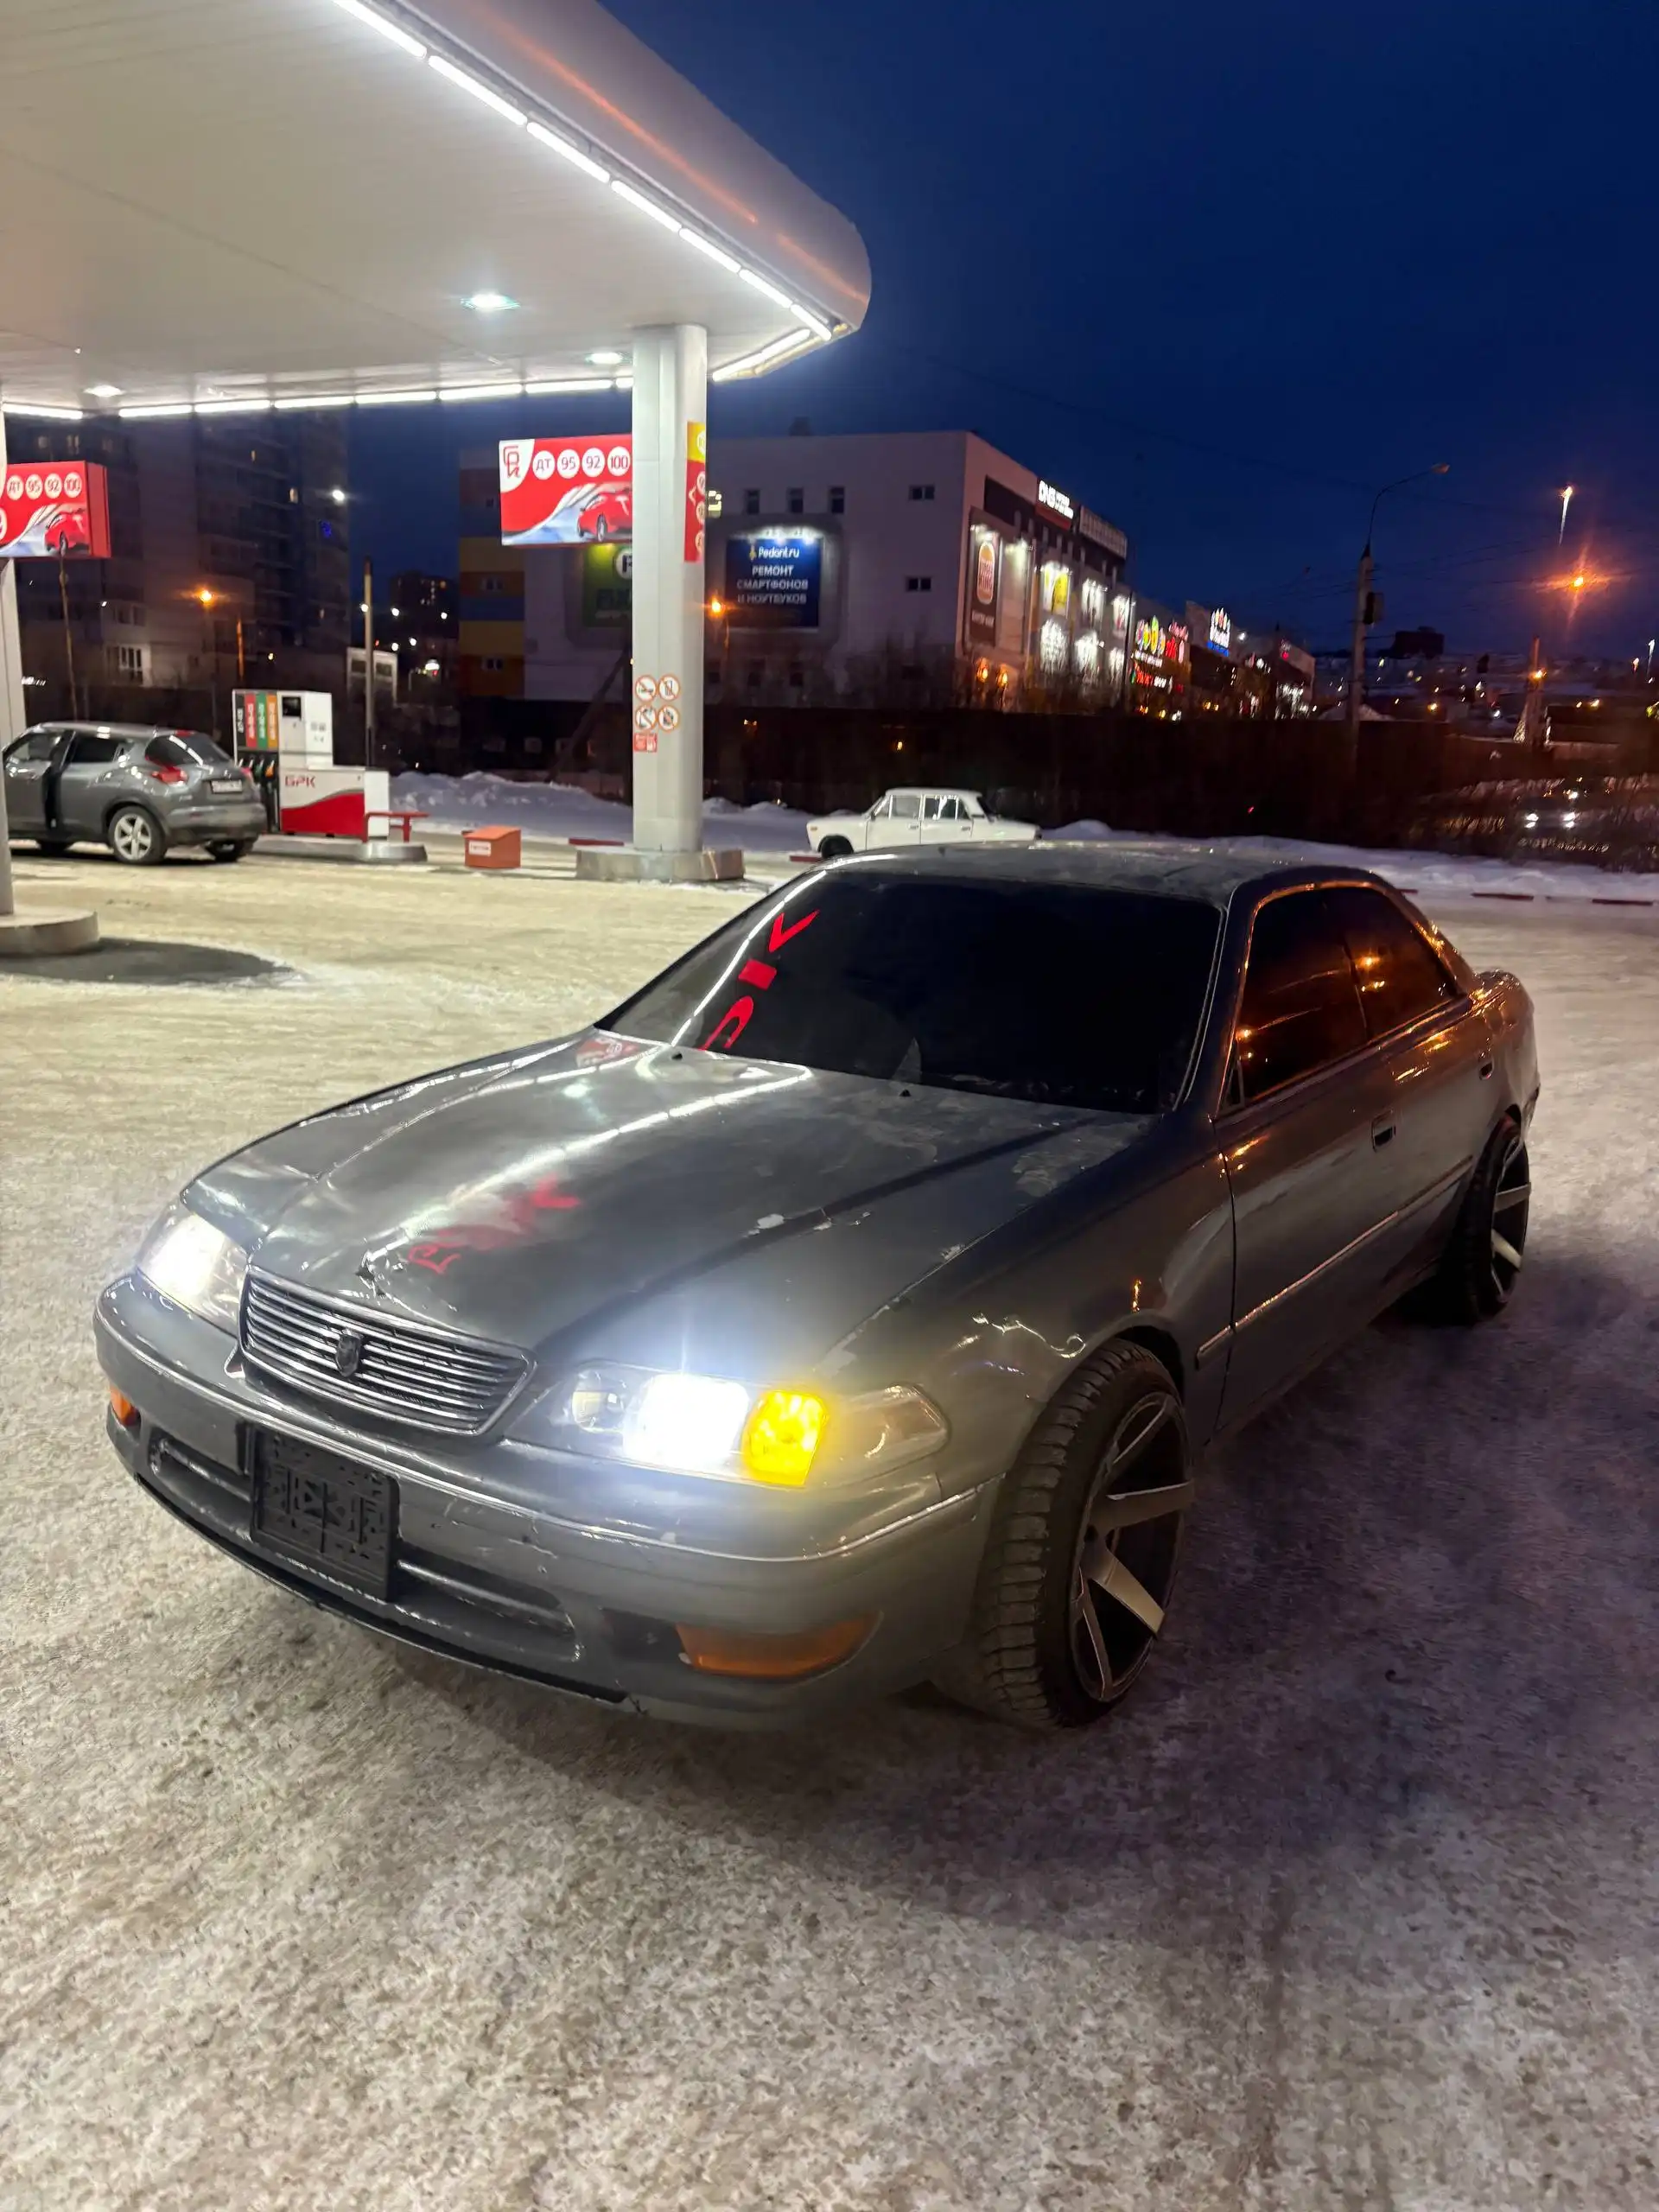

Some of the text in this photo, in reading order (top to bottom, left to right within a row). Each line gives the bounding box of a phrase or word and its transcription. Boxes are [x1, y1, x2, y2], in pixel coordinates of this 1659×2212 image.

[535, 454, 629, 472] ДТ 95 92 100
[752, 564, 795, 576] РЕМОНТ
[736, 579, 809, 590] СМАРТФОНОВ
[747, 593, 807, 604] НОУТБУКОВ
